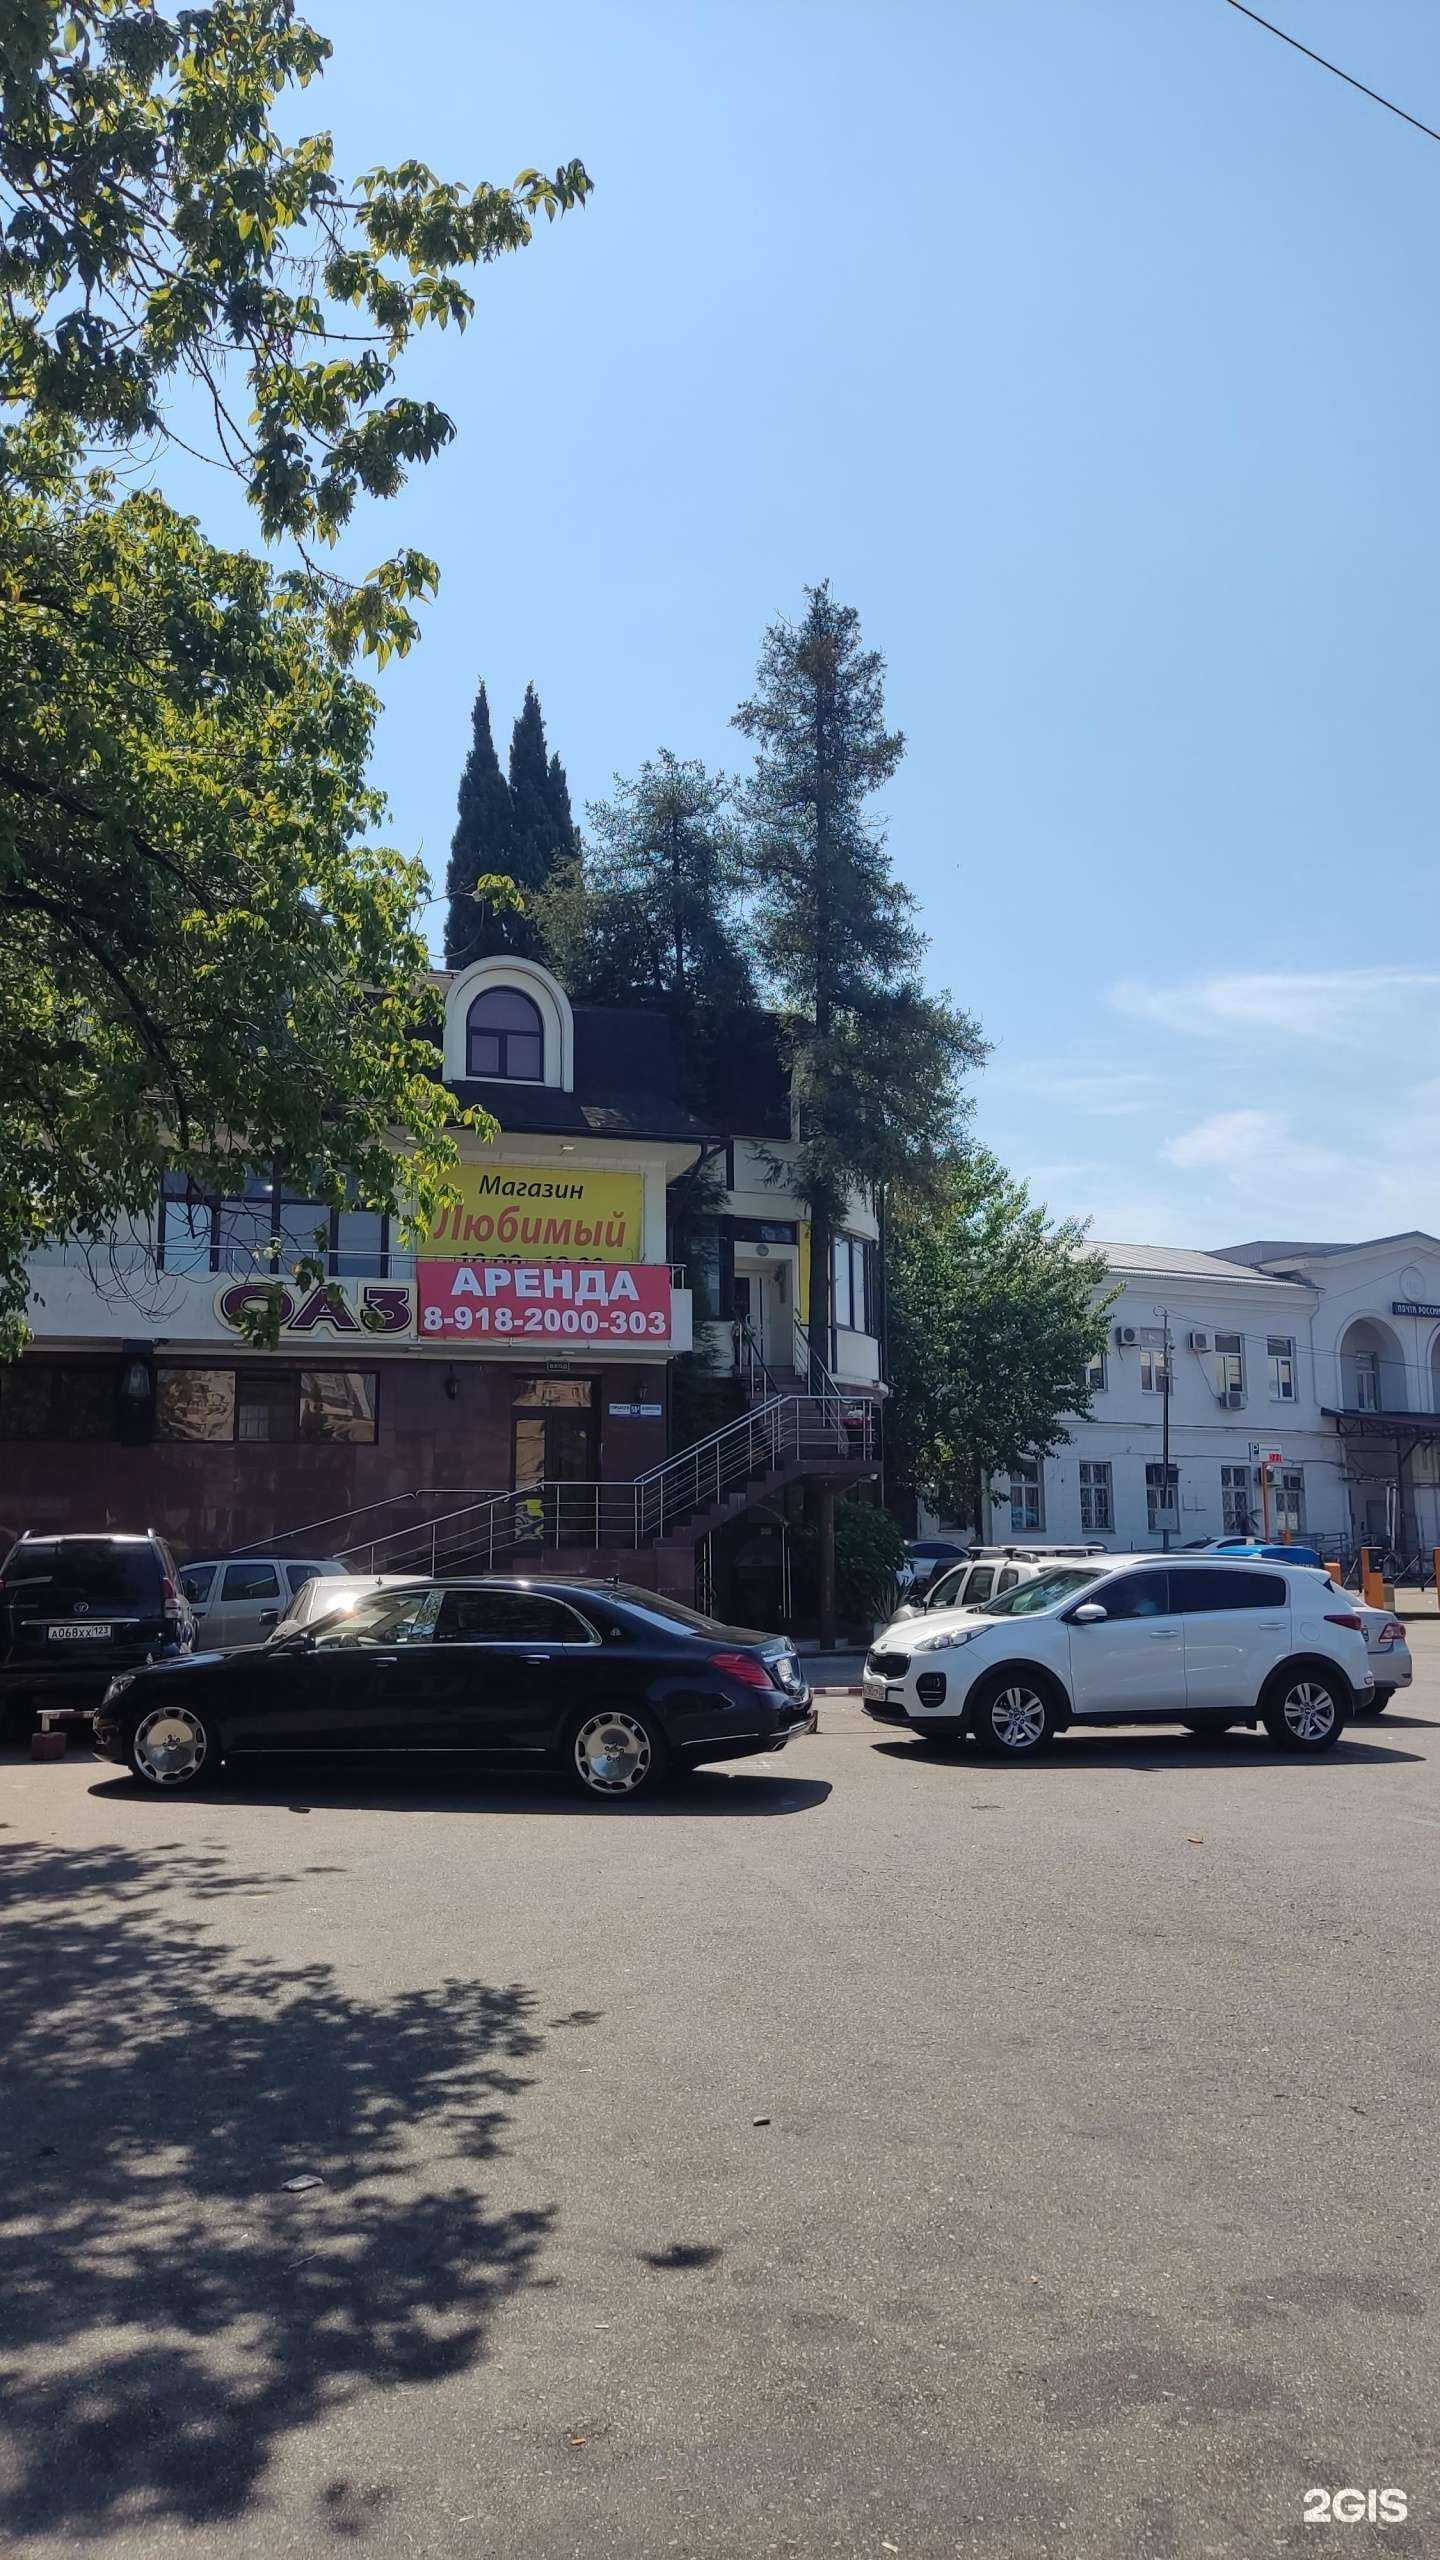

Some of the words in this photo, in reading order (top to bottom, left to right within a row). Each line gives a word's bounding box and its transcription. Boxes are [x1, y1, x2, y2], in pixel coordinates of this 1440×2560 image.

[478, 1174, 584, 1200] Магазин
[433, 1205, 627, 1248] Любимый
[450, 1267, 640, 1307] АРЕНДА
[423, 1306, 666, 1334] 8-918-2000-303
